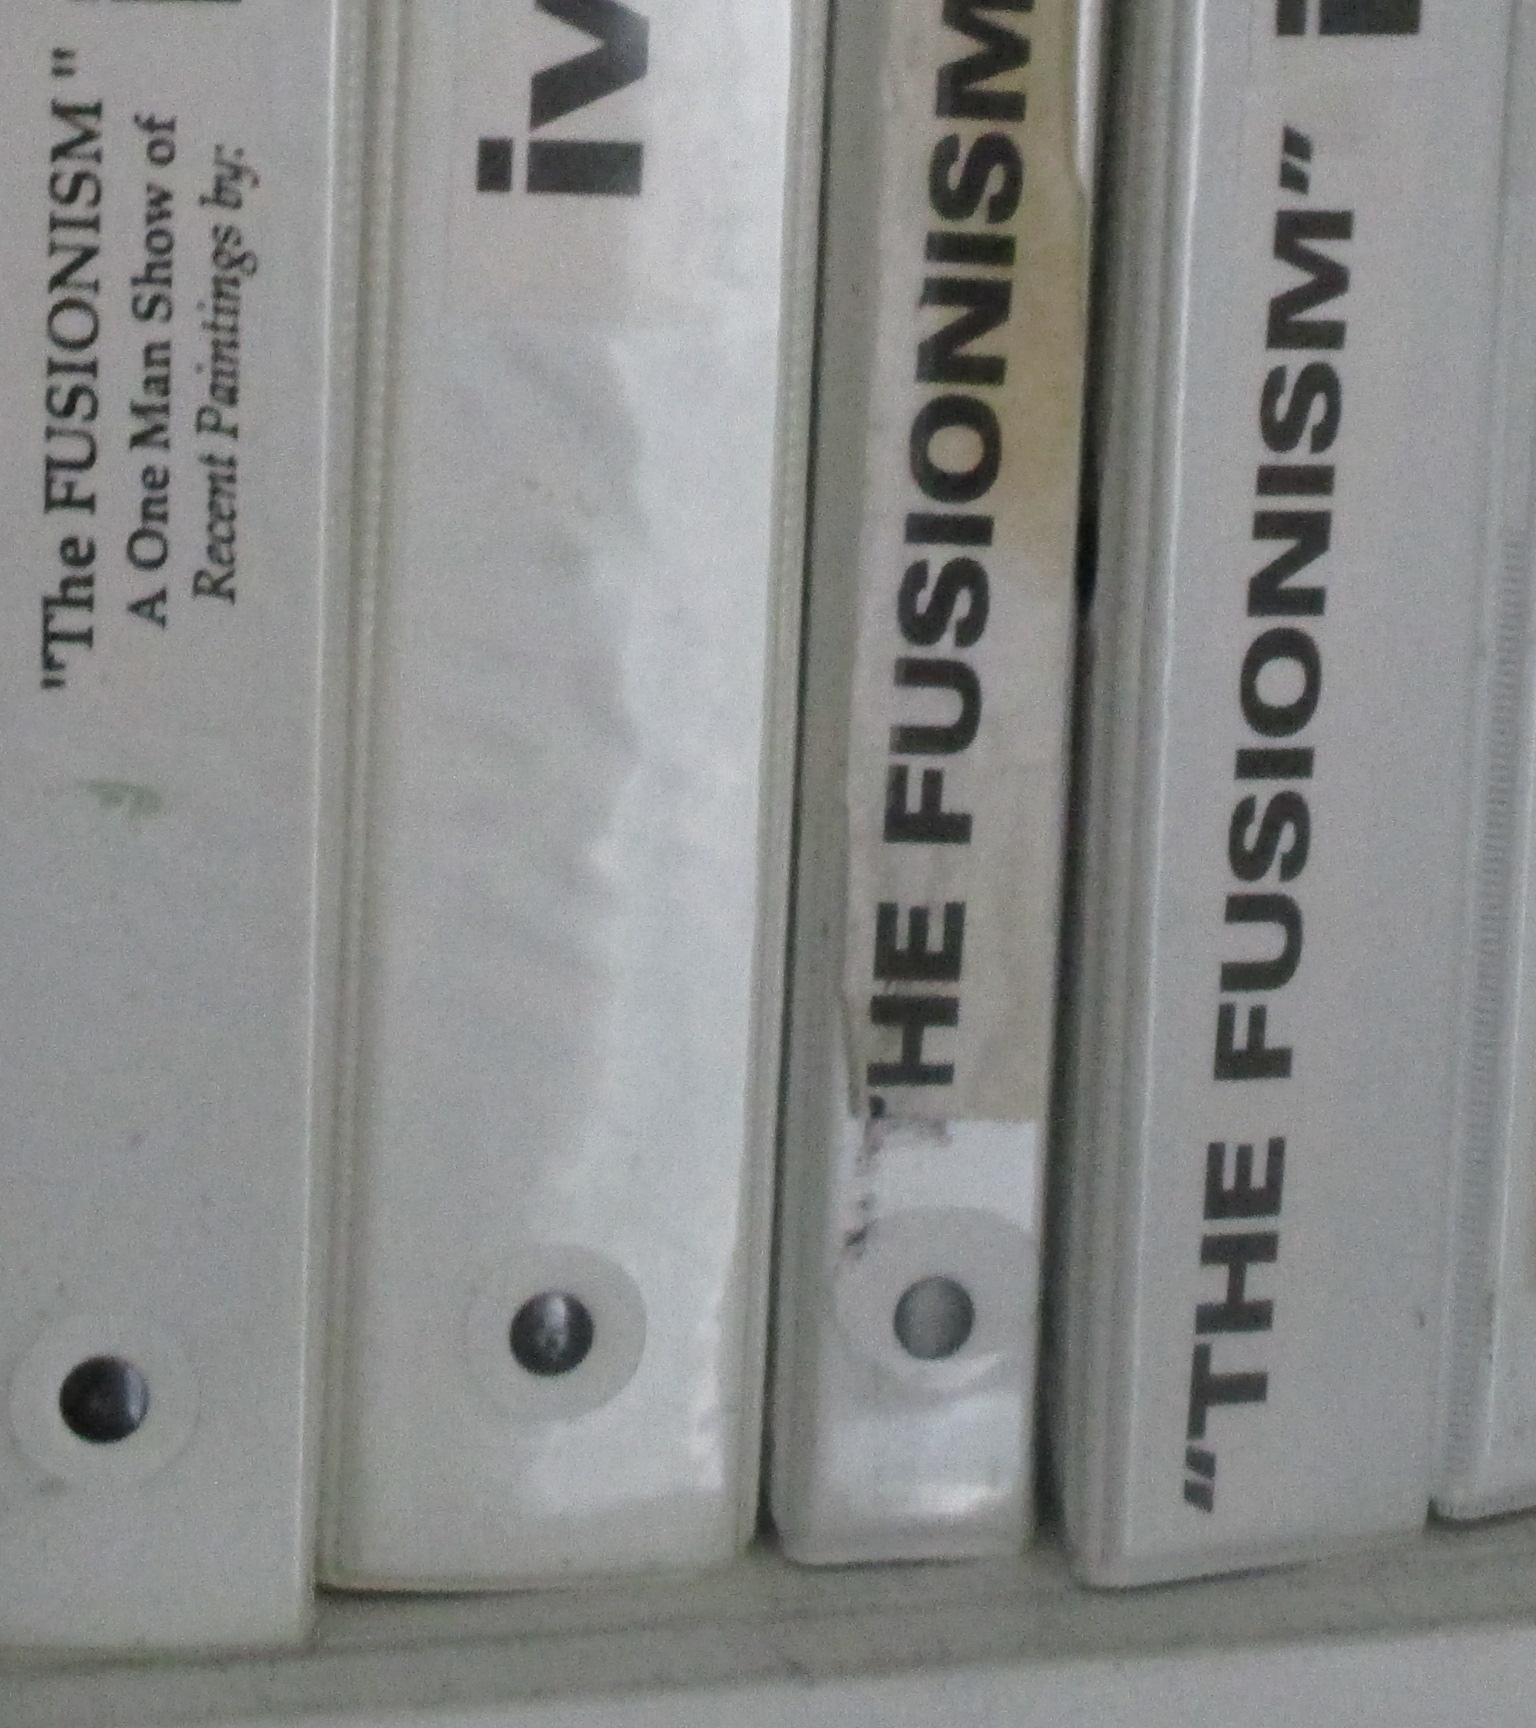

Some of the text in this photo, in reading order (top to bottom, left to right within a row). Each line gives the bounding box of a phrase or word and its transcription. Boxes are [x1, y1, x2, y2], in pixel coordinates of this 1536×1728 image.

[125, 114, 176, 629] A One Man Show of
[191, 144, 260, 605] Recent Paintings by:
[40, 535, 97, 690] "The
[1212, 125, 1354, 1082] FUSIONISM"
[1182, 1136, 1286, 1513] "THE
